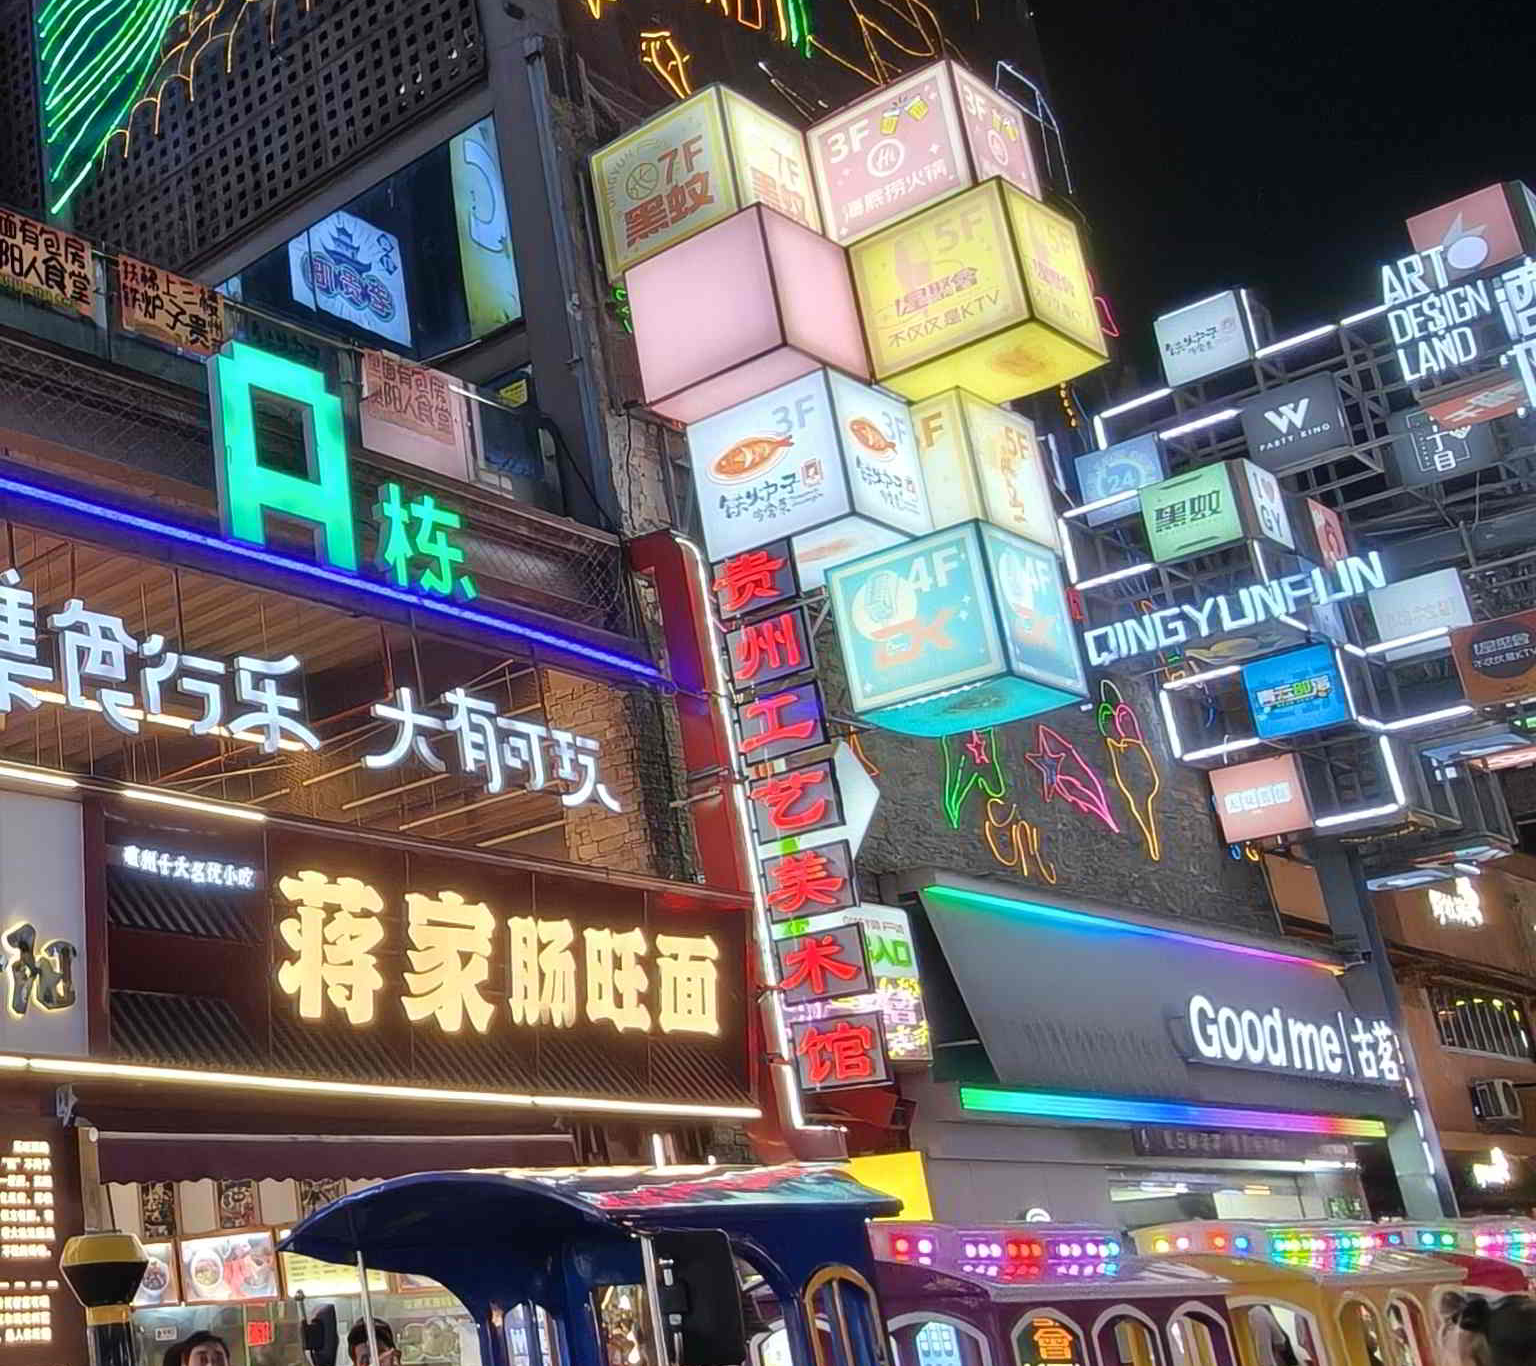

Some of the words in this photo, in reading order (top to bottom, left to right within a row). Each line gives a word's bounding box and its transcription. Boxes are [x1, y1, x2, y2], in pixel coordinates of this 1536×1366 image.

[964, 88, 987, 122] 3F
[657, 134, 704, 184] 7F
[827, 117, 870, 165] 3F
[932, 208, 987, 256] 5F
[1380, 244, 1450, 308] ART
[887, 289, 1002, 349] 不仅仅是KTV
[1386, 278, 1492, 346] DESIGN
[1396, 326, 1478, 383] LAND
[771, 395, 815, 437] 3F
[881, 411, 907, 443] 3F
[907, 546, 960, 593] 4F
[1086, 550, 1387, 666] QINGYUNFUN
[364, 686, 623, 814] 大有可玩
[710, 549, 875, 1091] 贵州工艺美术馆
[276, 868, 722, 1037] 蒋家肠旺面
[1188, 993, 1281, 1073] Good
[1292, 1017, 1343, 1075] me
[1350, 1018, 1401, 1083] 古茗
